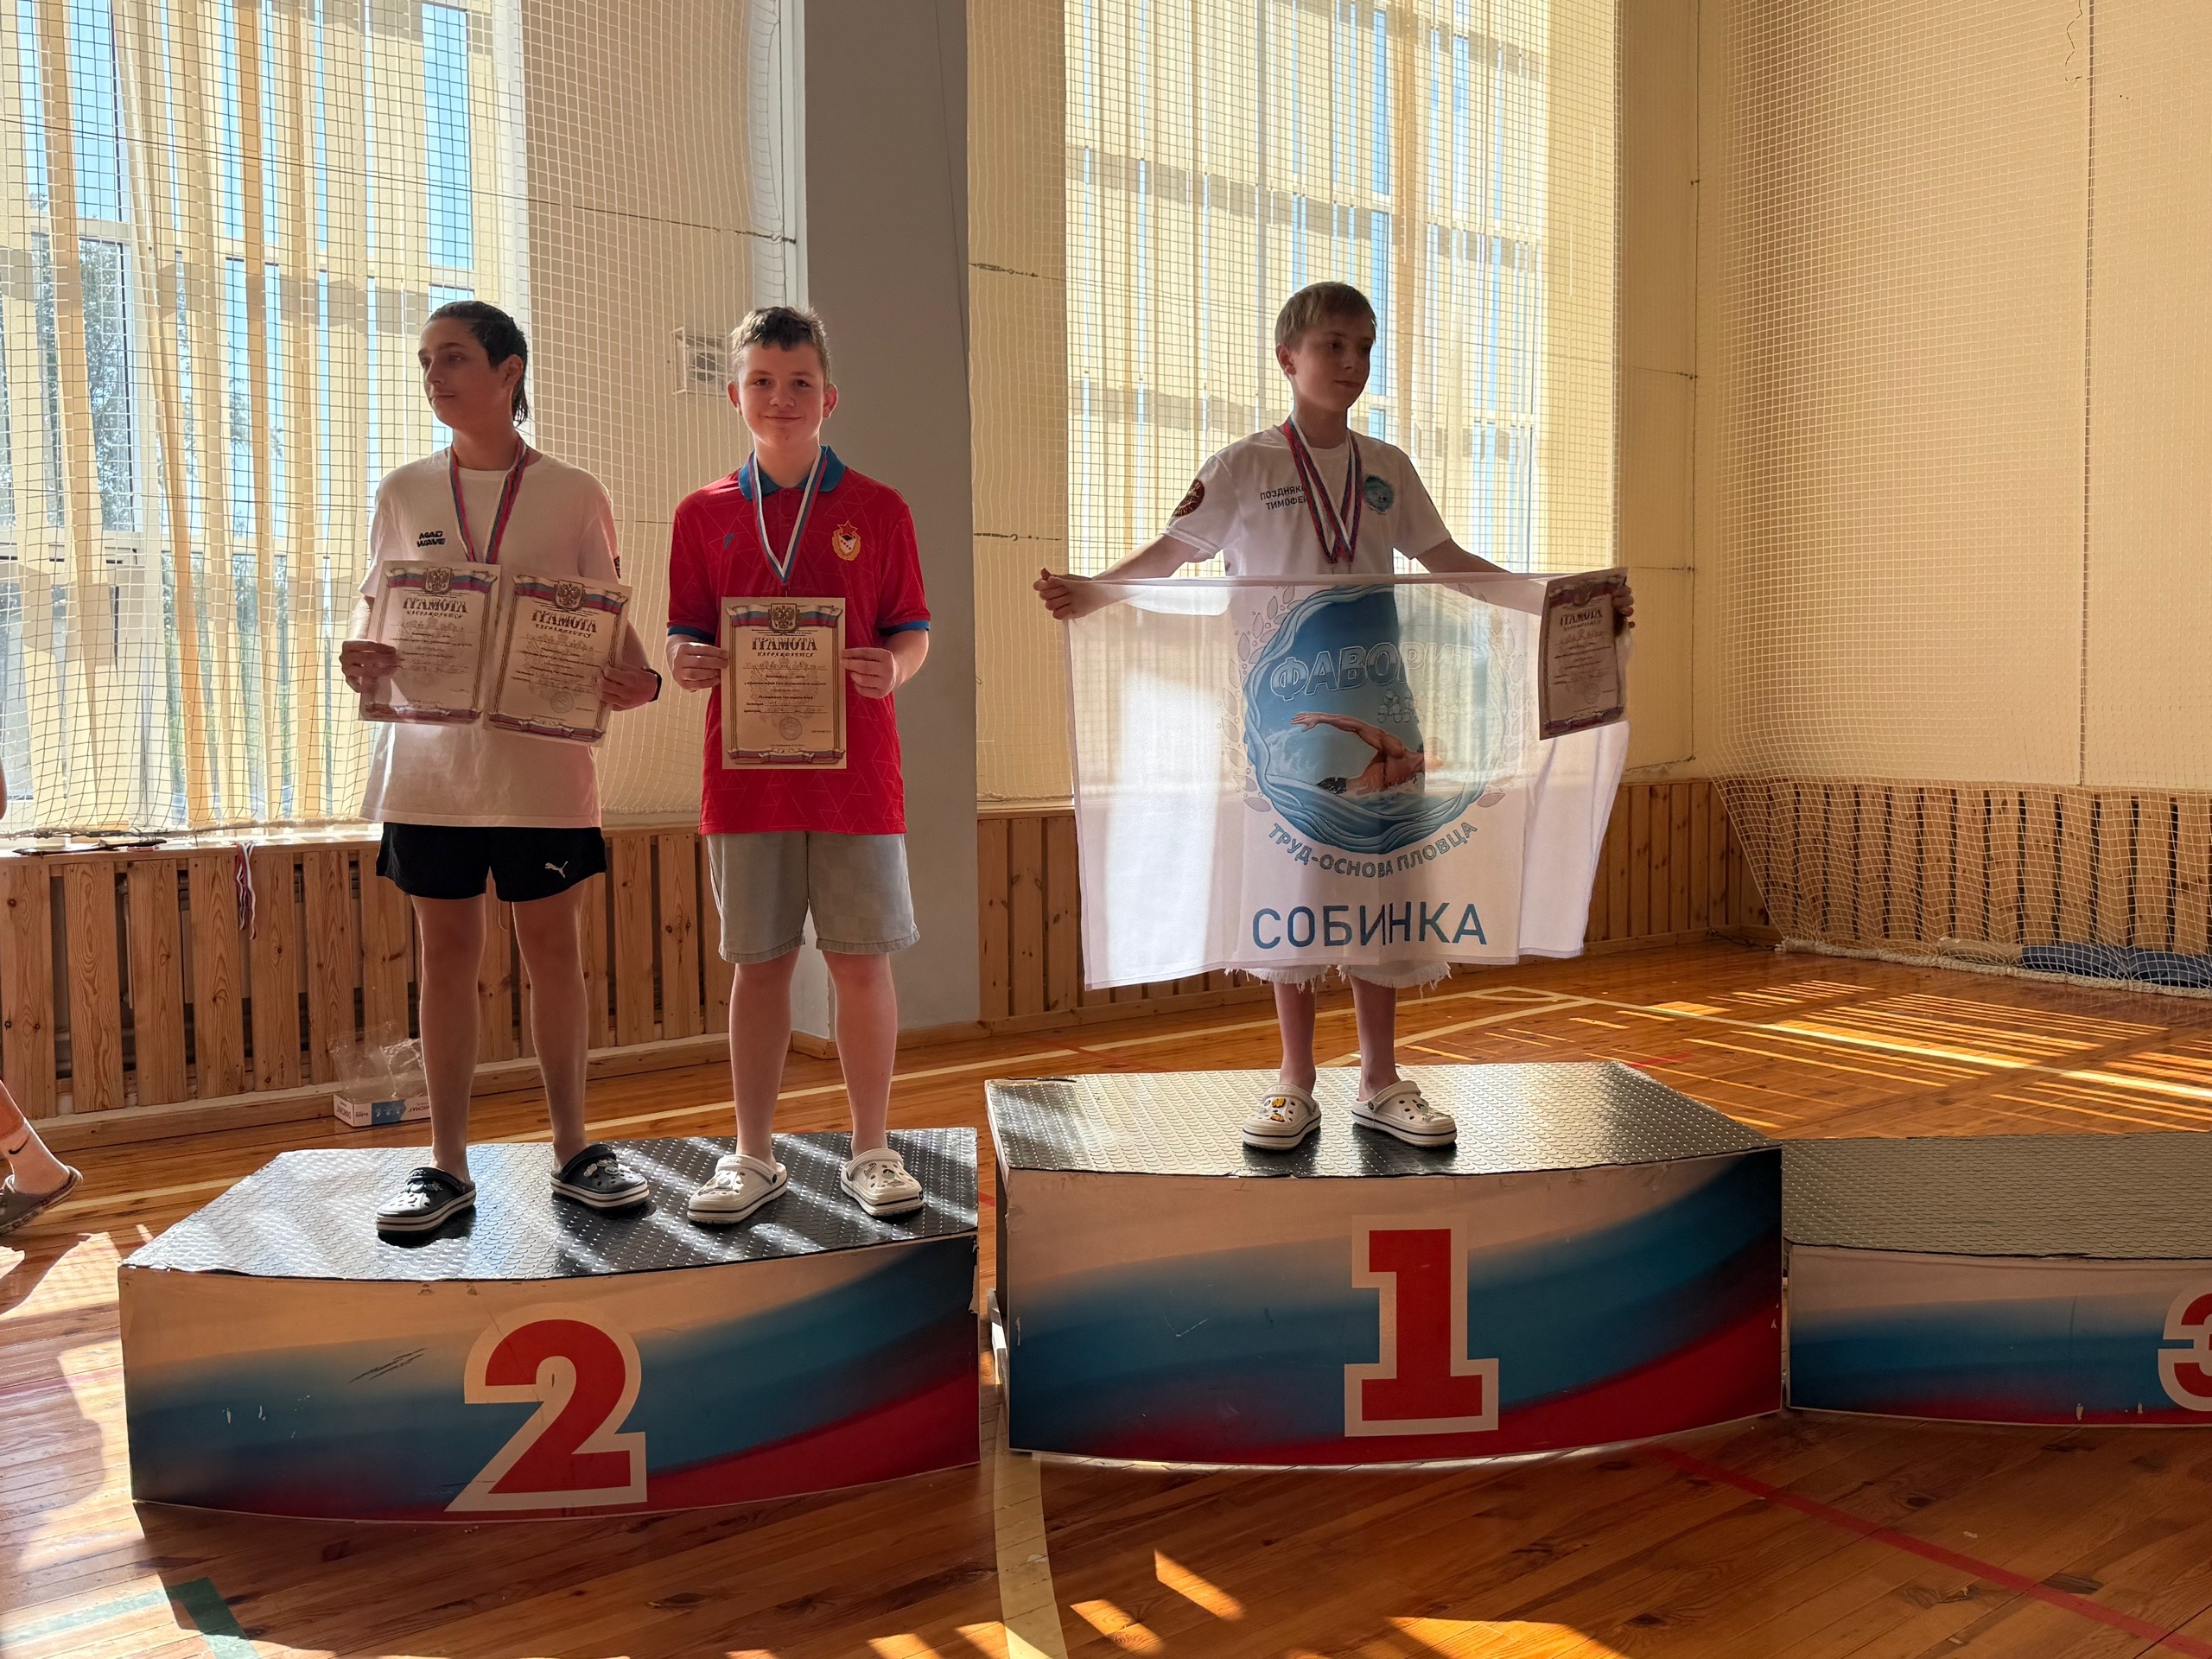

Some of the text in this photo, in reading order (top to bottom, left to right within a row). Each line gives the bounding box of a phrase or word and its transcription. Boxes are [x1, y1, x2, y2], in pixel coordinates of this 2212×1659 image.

[403, 597, 467, 613] ГРАМОТА
[531, 609, 597, 632] ГРАМОТА
[752, 637, 817, 651] ГРАМОТА
[1270, 642, 1478, 702] ФАВОРИТ
[1397, 822, 1478, 871] ПЛОВЦА
[1253, 901, 1487, 949] СОБИНКА
[1344, 1216, 1498, 1436] 1
[444, 1303, 646, 1512] 2
